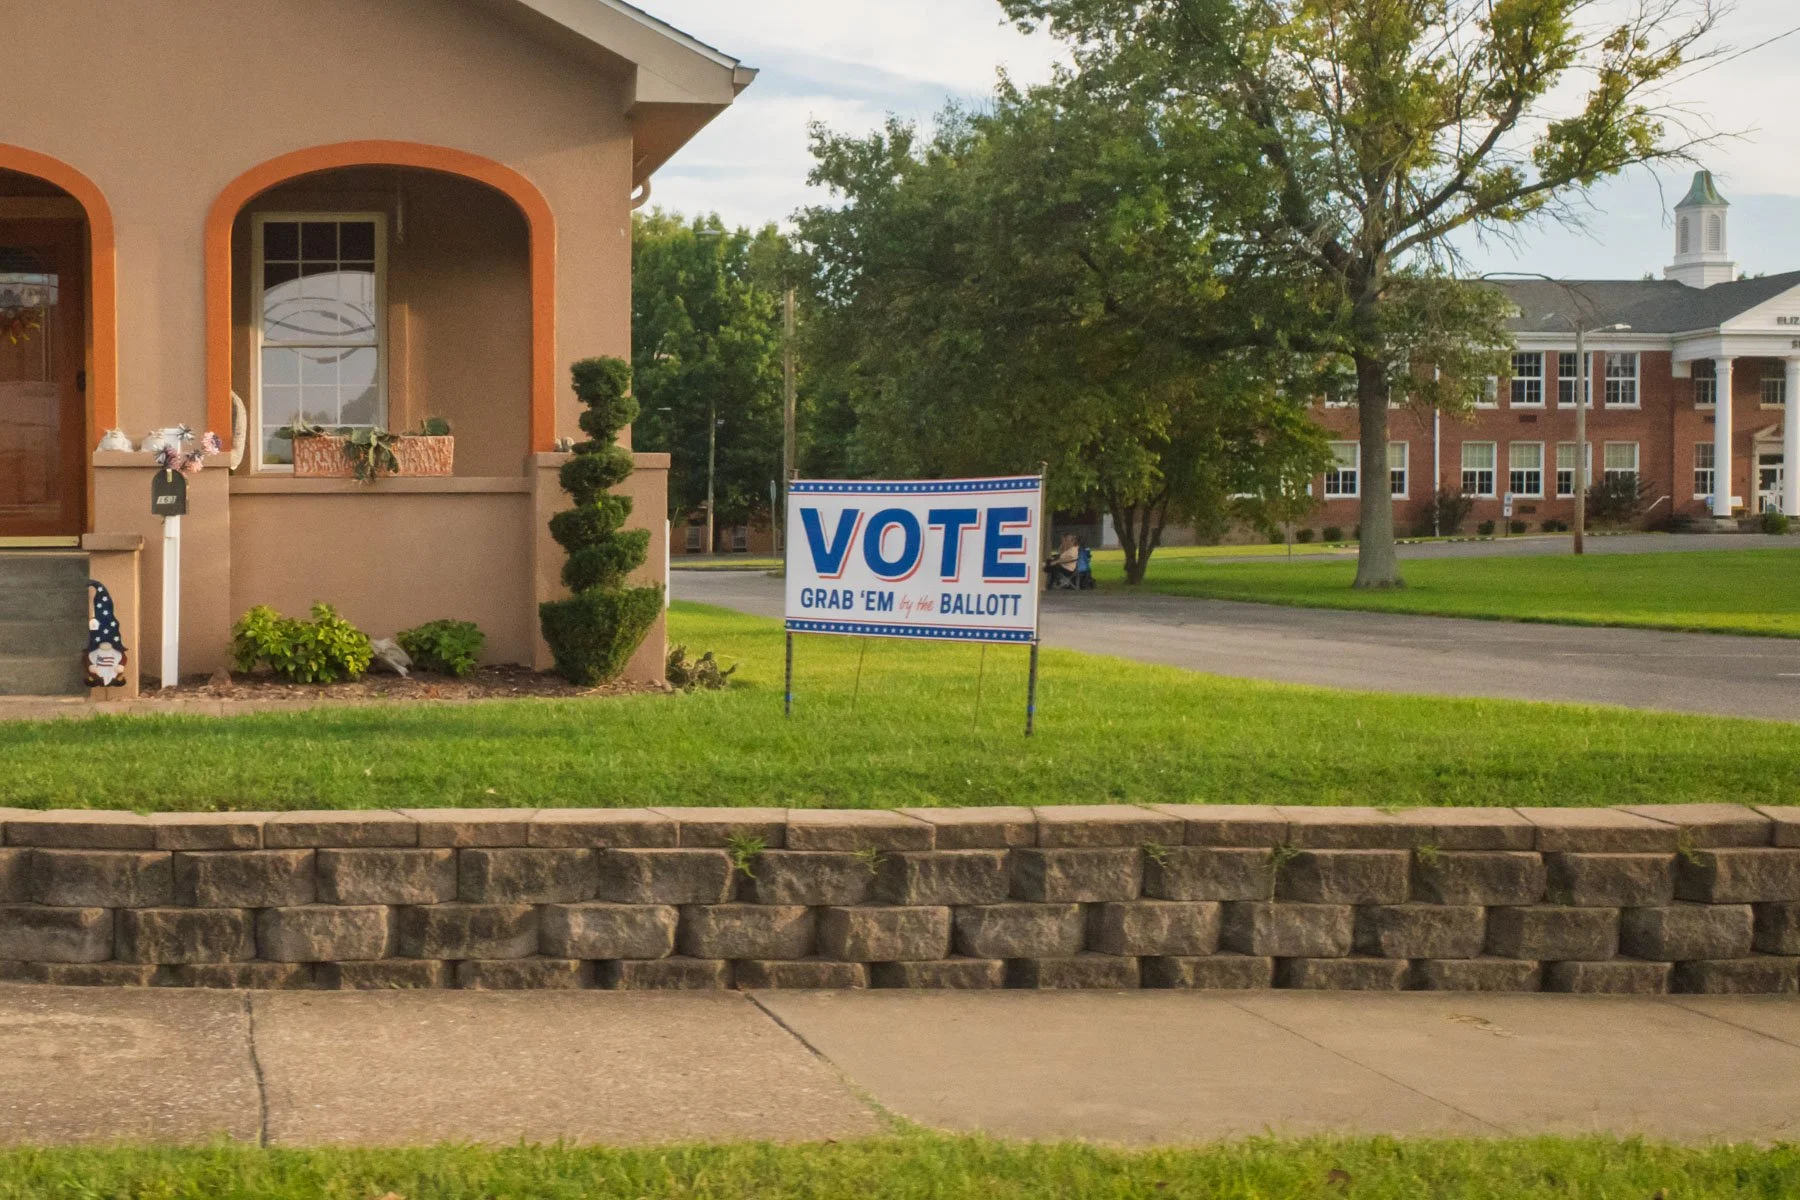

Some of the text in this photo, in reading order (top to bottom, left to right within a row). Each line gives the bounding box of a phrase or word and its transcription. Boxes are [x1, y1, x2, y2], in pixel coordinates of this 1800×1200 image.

[800, 507, 1032, 583] VOTE
[801, 588, 854, 609] GRAB
[898, 595, 912, 618] by
[916, 595, 934, 612] the
[940, 593, 1022, 616] BALLOTT
